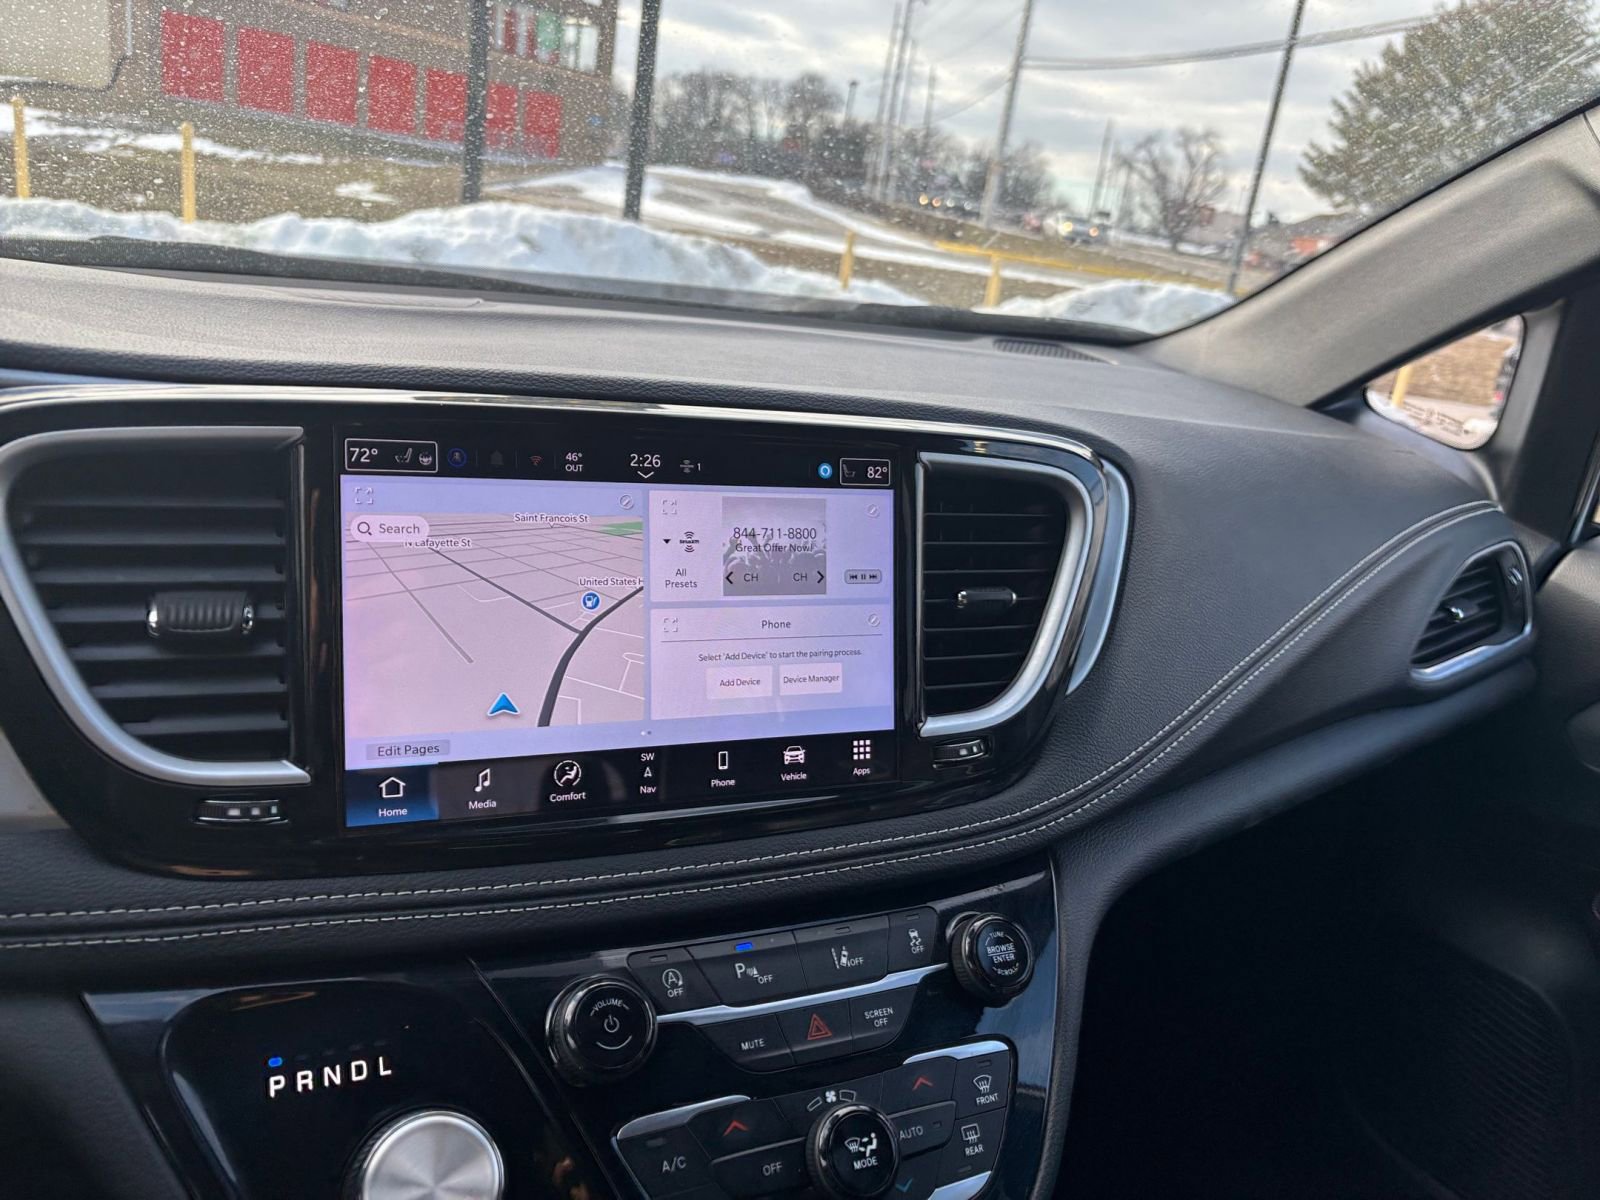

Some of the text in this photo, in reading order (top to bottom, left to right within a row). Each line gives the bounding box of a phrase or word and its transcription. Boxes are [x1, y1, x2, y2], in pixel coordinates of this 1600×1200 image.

[350, 447, 378, 463] 72°
[565, 452, 583, 462] 46°
[630, 453, 661, 468] 2:26
[565, 464, 584, 472] OUT
[867, 466, 888, 479] 82°
[514, 513, 588, 524] Saint Francois St
[378, 522, 420, 535] Search
[733, 526, 817, 540] 844-711-8800
[415, 538, 459, 549] Lafayette
[461, 538, 471, 547] St
[735, 542, 814, 552] Great Offer Now!
[675, 569, 687, 577] All
[743, 573, 759, 582] CH
[793, 572, 808, 582] CH
[579, 578, 609, 586] United
[610, 578, 637, 586] States
[665, 580, 698, 588] Presets
[761, 619, 792, 630] Phone
[698, 653, 721, 662] Select
[796, 650, 808, 658] the
[809, 649, 834, 658] pairing
[834, 649, 862, 658] process.
[719, 678, 761, 687] Add Device
[783, 674, 840, 684] Device Manager
[377, 744, 440, 757] Edit Pages
[640, 753, 655, 761] SW
[781, 772, 807, 781] Vehicle
[853, 766, 871, 776] Apps
[711, 778, 736, 788] Phone
[639, 785, 656, 794] Nav
[549, 791, 586, 802] Comfort
[468, 799, 497, 810] Media
[378, 807, 408, 818] Home
[911, 946, 924, 954] OFF
[986, 942, 1016, 954] BROWSE
[850, 957, 864, 967] OFF
[992, 953, 1015, 964] ENTER
[734, 962, 746, 979] P
[757, 974, 773, 985] OFF
[667, 987, 684, 998] OFF
[592, 998, 623, 1011] VOLUME
[864, 1007, 893, 1020] SCREEN
[873, 1017, 889, 1028] OFF
[740, 1038, 765, 1051] MUTE
[269, 1056, 392, 1098] P R N D L
[975, 1092, 999, 1106] FRONT
[899, 1125, 924, 1141] AUTO
[964, 1144, 984, 1157] REAR
[661, 1155, 687, 1174] A/C
[762, 1161, 783, 1177] OFF
[853, 1156, 878, 1171] MODE
